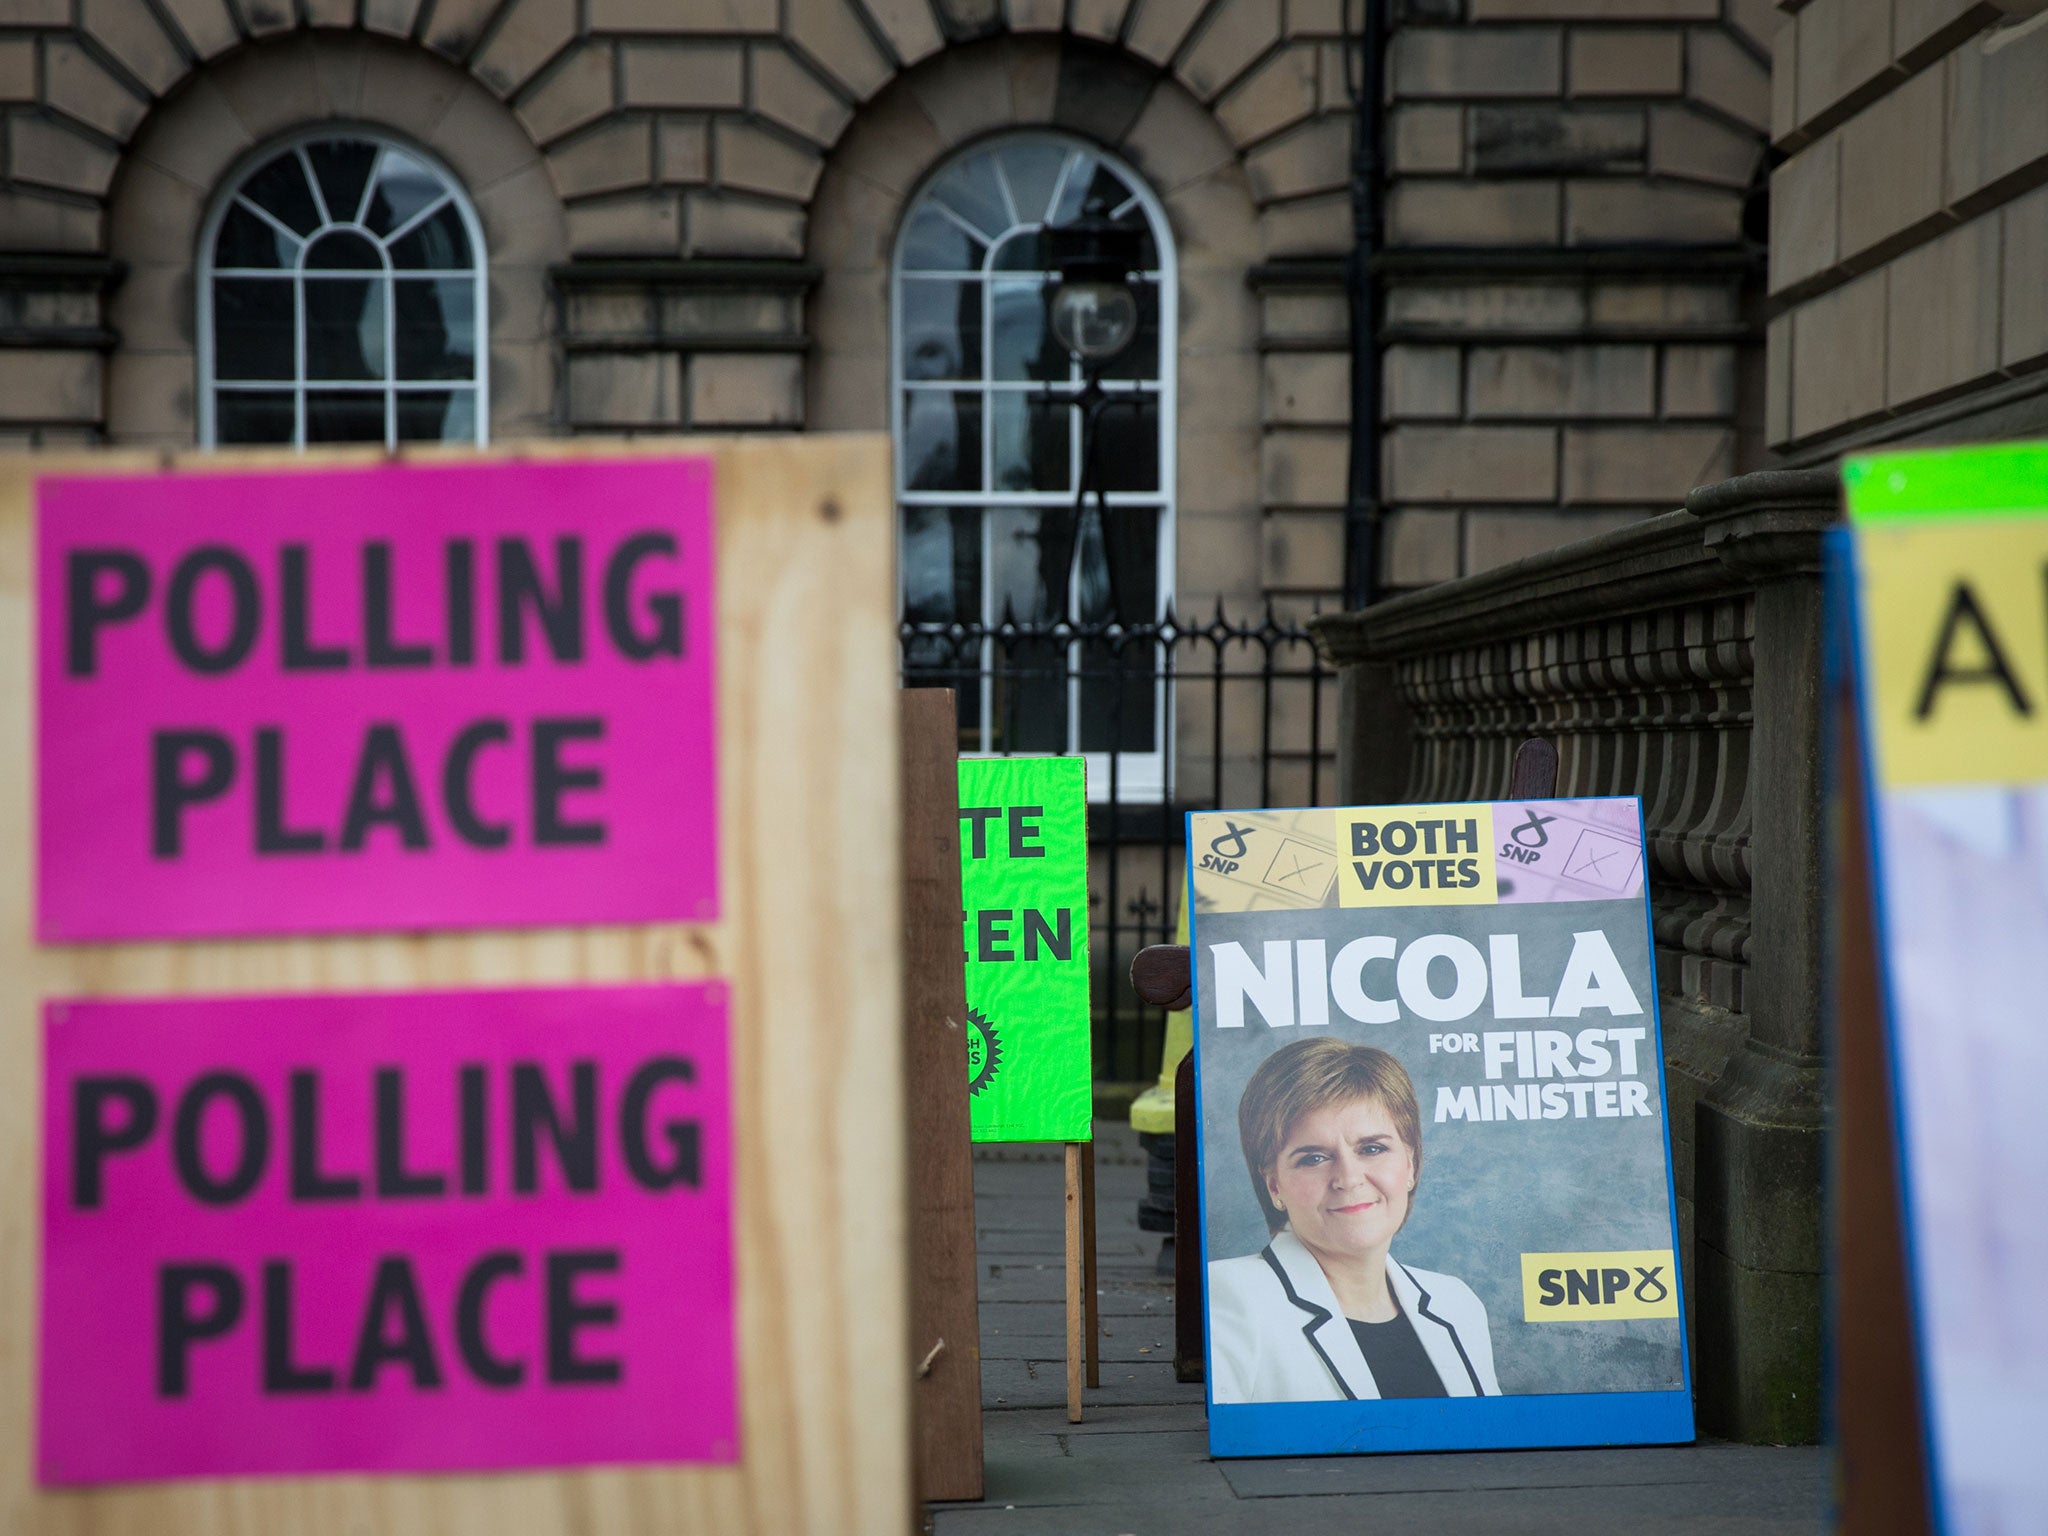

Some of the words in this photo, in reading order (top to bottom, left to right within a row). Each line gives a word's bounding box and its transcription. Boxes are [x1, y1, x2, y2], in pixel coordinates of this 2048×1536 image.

[64, 530, 686, 680] POLLING
[1913, 562, 2048, 723] A
[150, 716, 608, 860] PLACE
[1351, 818, 1479, 856] BOTH
[1499, 843, 1542, 865] SNP
[1199, 853, 1240, 875] SNP
[1352, 858, 1481, 890] VOTES
[962, 908, 1072, 962] EN
[1209, 929, 1644, 1028] NICOLA
[1429, 1033, 1480, 1054] FOR
[1483, 1027, 1646, 1079] FIRST
[1434, 1081, 1653, 1123] MINISTER
[70, 1055, 703, 1210] POLLING
[1538, 1267, 1631, 1306] SNP
[156, 1248, 624, 1398] PLACE
